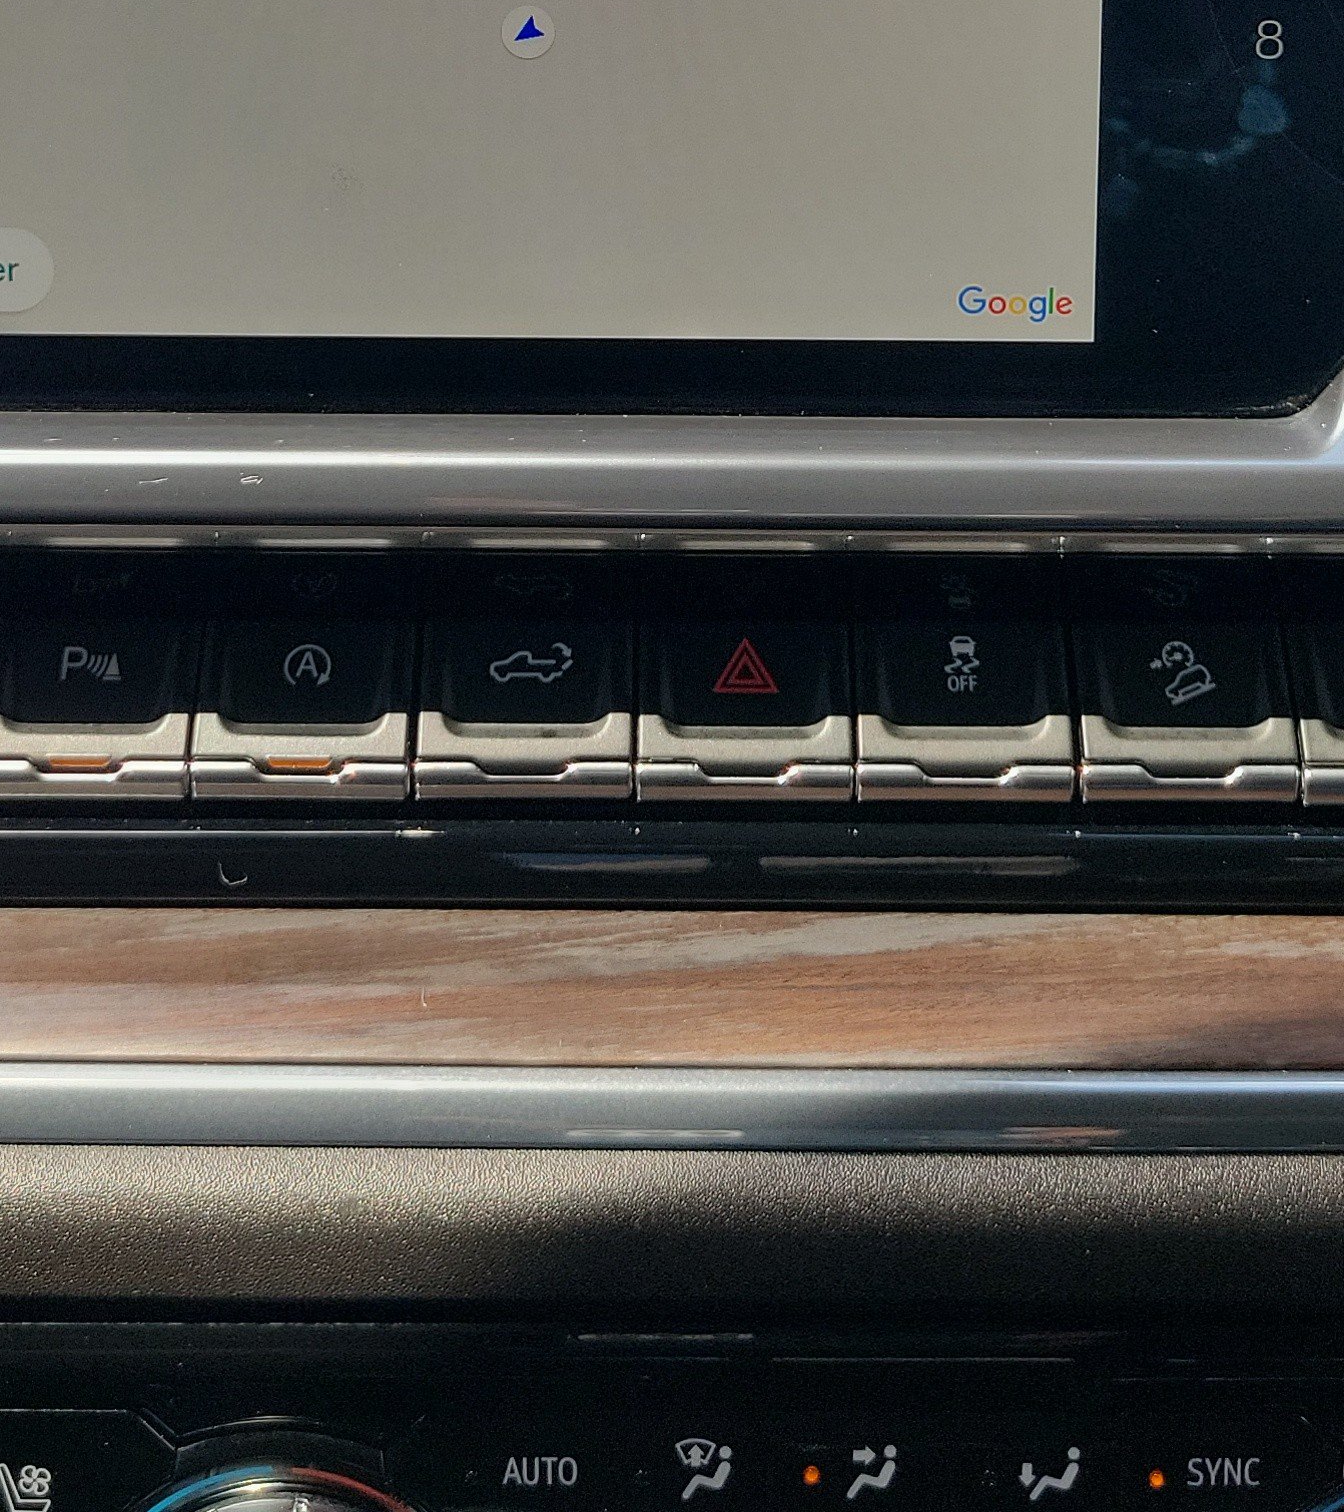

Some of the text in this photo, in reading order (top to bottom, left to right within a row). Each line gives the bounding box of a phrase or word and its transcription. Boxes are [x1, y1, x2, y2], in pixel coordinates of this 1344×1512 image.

[1255, 19, 1285, 60] 8
[958, 285, 1073, 323] Google
[947, 675, 978, 692] OFF
[501, 1455, 579, 1487] AUTO
[1186, 1457, 1261, 1488] SYNC
